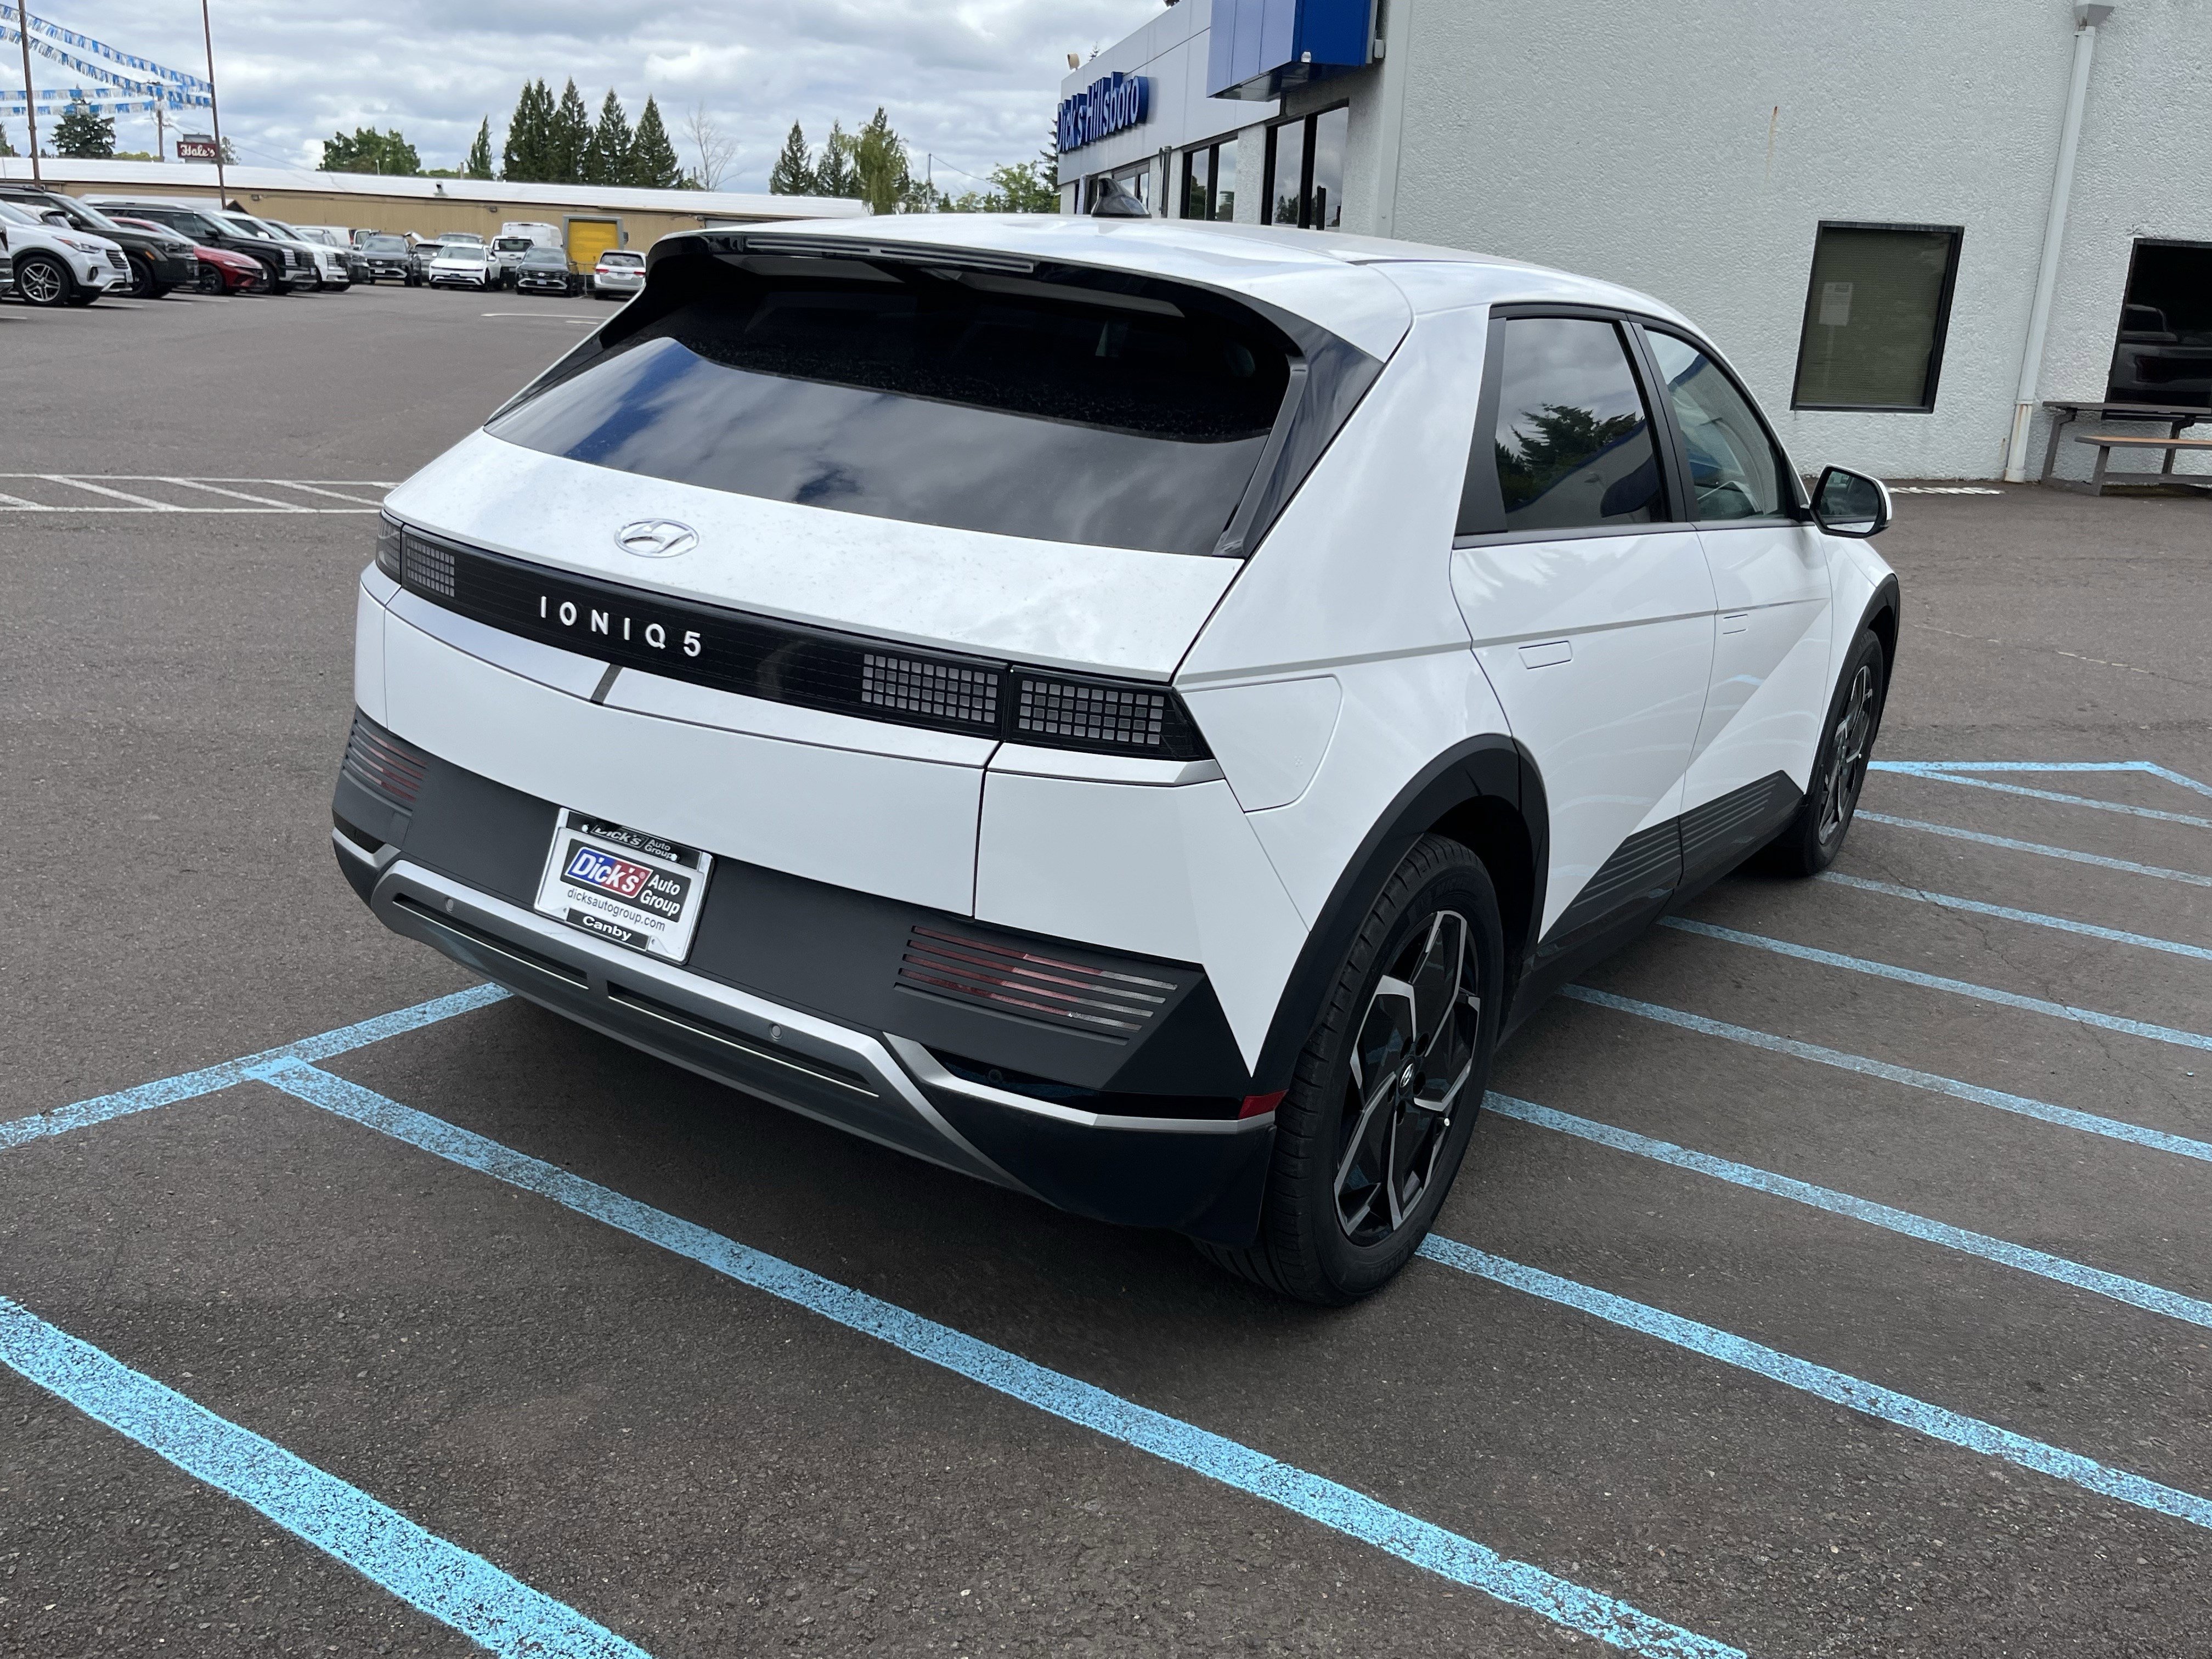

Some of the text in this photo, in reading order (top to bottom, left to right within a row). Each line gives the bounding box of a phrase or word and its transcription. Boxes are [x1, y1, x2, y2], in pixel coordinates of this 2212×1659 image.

[1057, 72, 1142, 152] Dick's Hillsboro
[540, 596, 702, 657] IONIQ 5
[648, 839, 671, 851] Auto
[572, 853, 681, 895] Dick's Auto
[567, 888, 665, 932] dicksautogroup.com
[640, 890, 681, 916] Group
[583, 916, 631, 942] Canby
